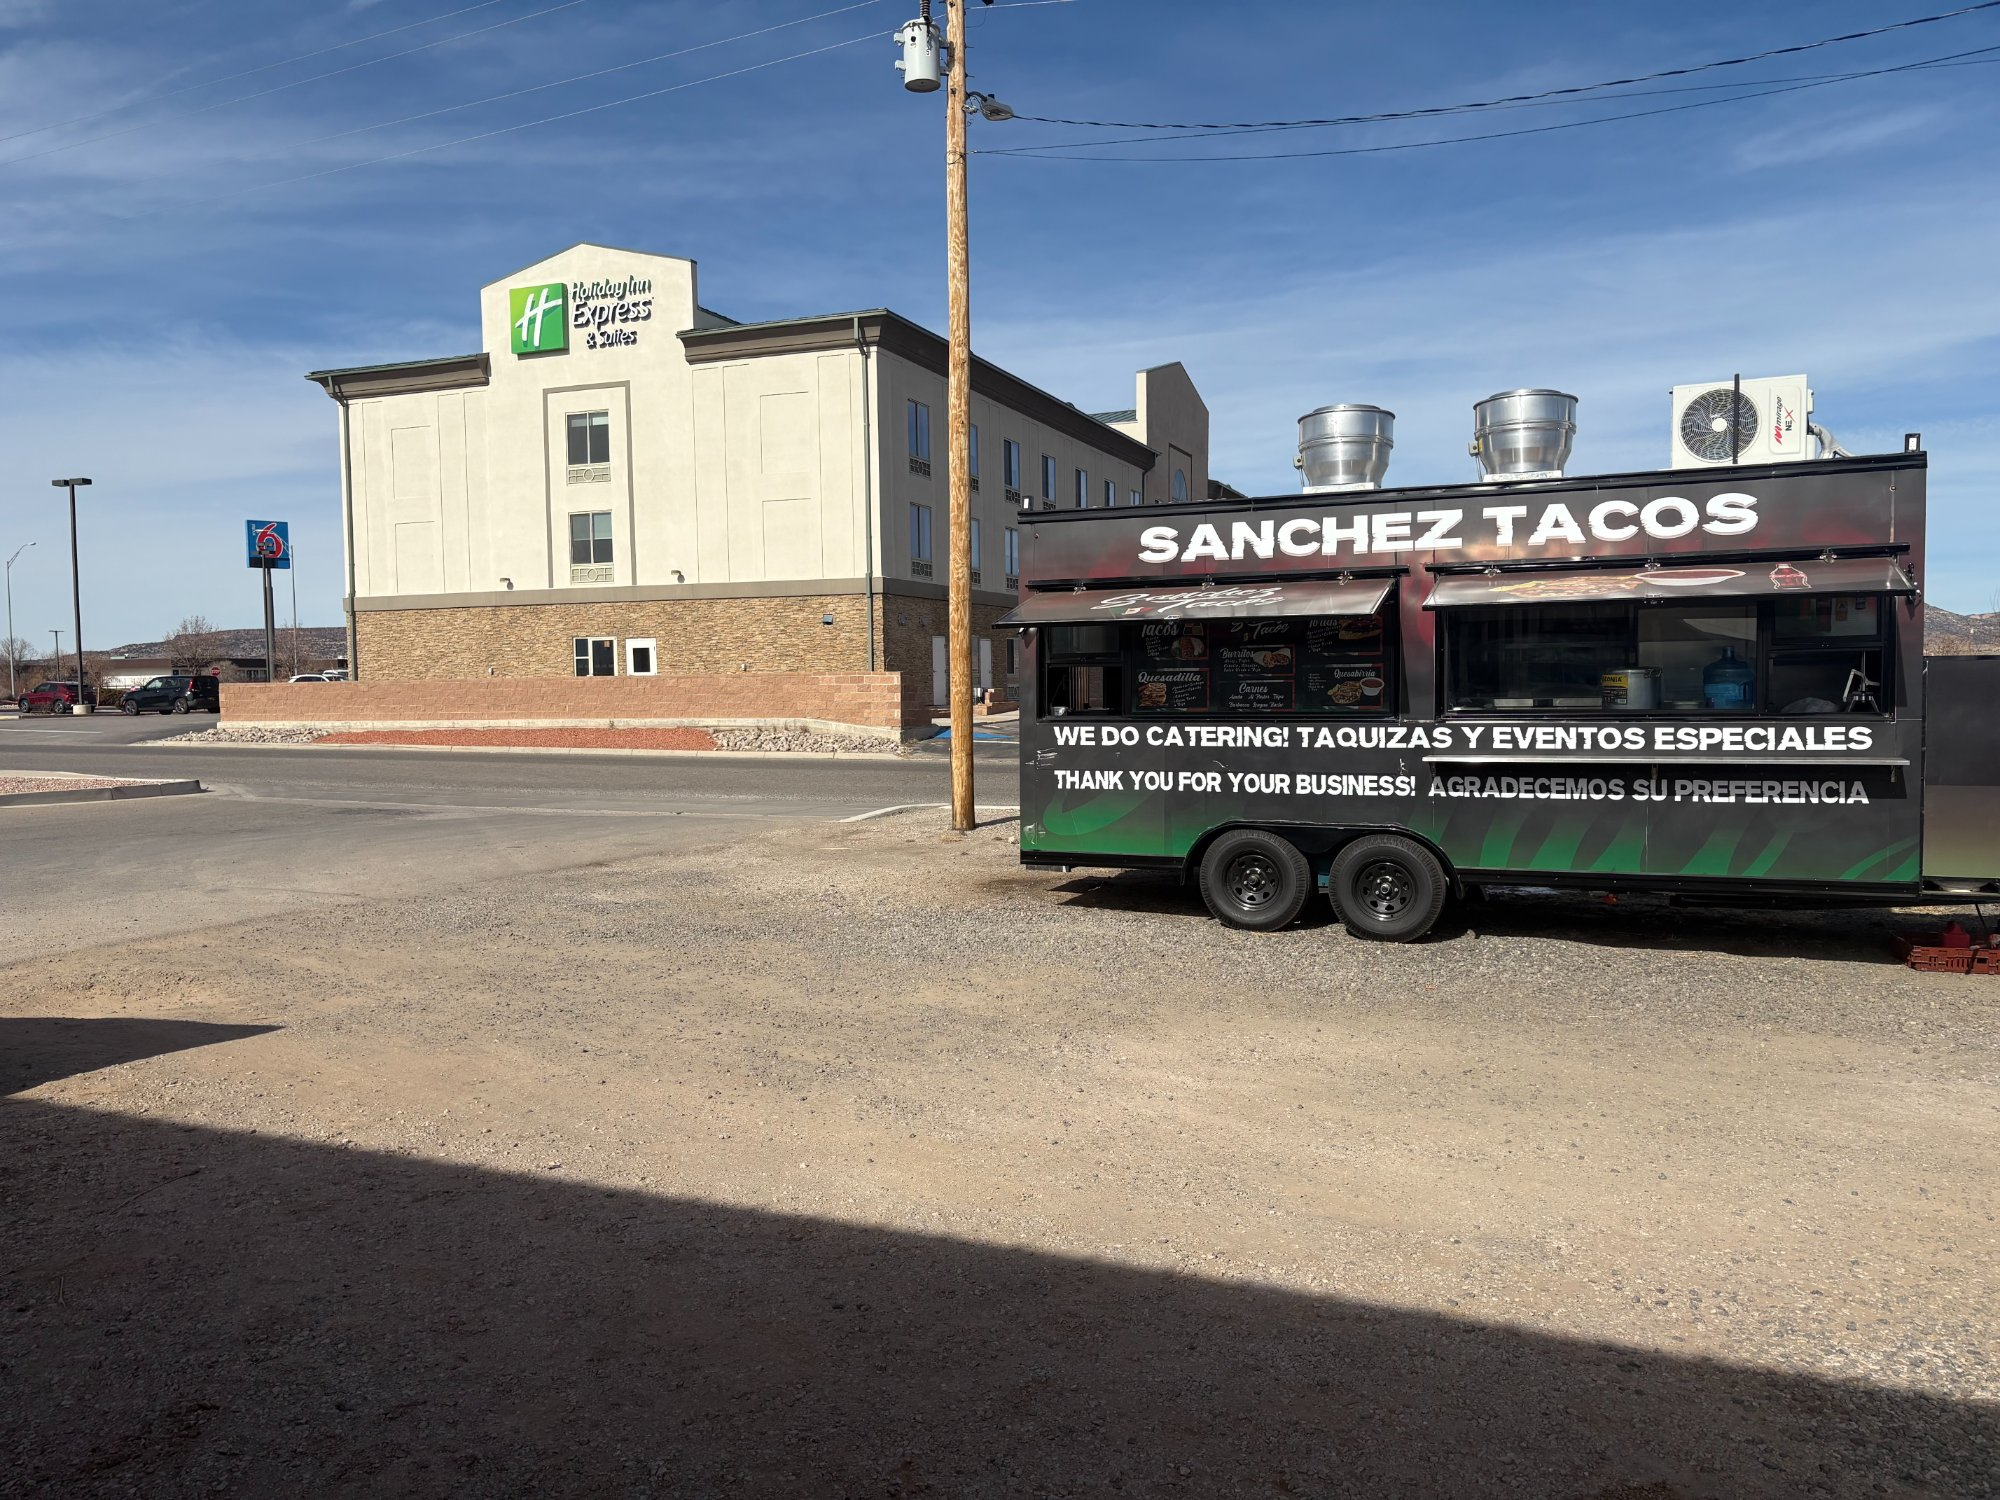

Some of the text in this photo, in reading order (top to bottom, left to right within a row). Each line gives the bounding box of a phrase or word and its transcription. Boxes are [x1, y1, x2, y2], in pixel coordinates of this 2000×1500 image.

[571, 275, 652, 301] Holiday Inn
[573, 299, 653, 329] Express
[587, 329, 637, 349] & Suites
[1138, 492, 1759, 563] SANCHEZ TACOS
[1220, 648, 1254, 659] Burritos
[1138, 671, 1202, 683] Quesadilla
[1239, 682, 1269, 693] Carnes
[1053, 726, 1873, 751] WE DO CATERING! TAQUIZAS Y EVENTOS ESPECIALES
[1054, 770, 1870, 805] THANK YOU FOR YOUR BUSINESS! AGRADECEMOS SU PREFERENCIA
